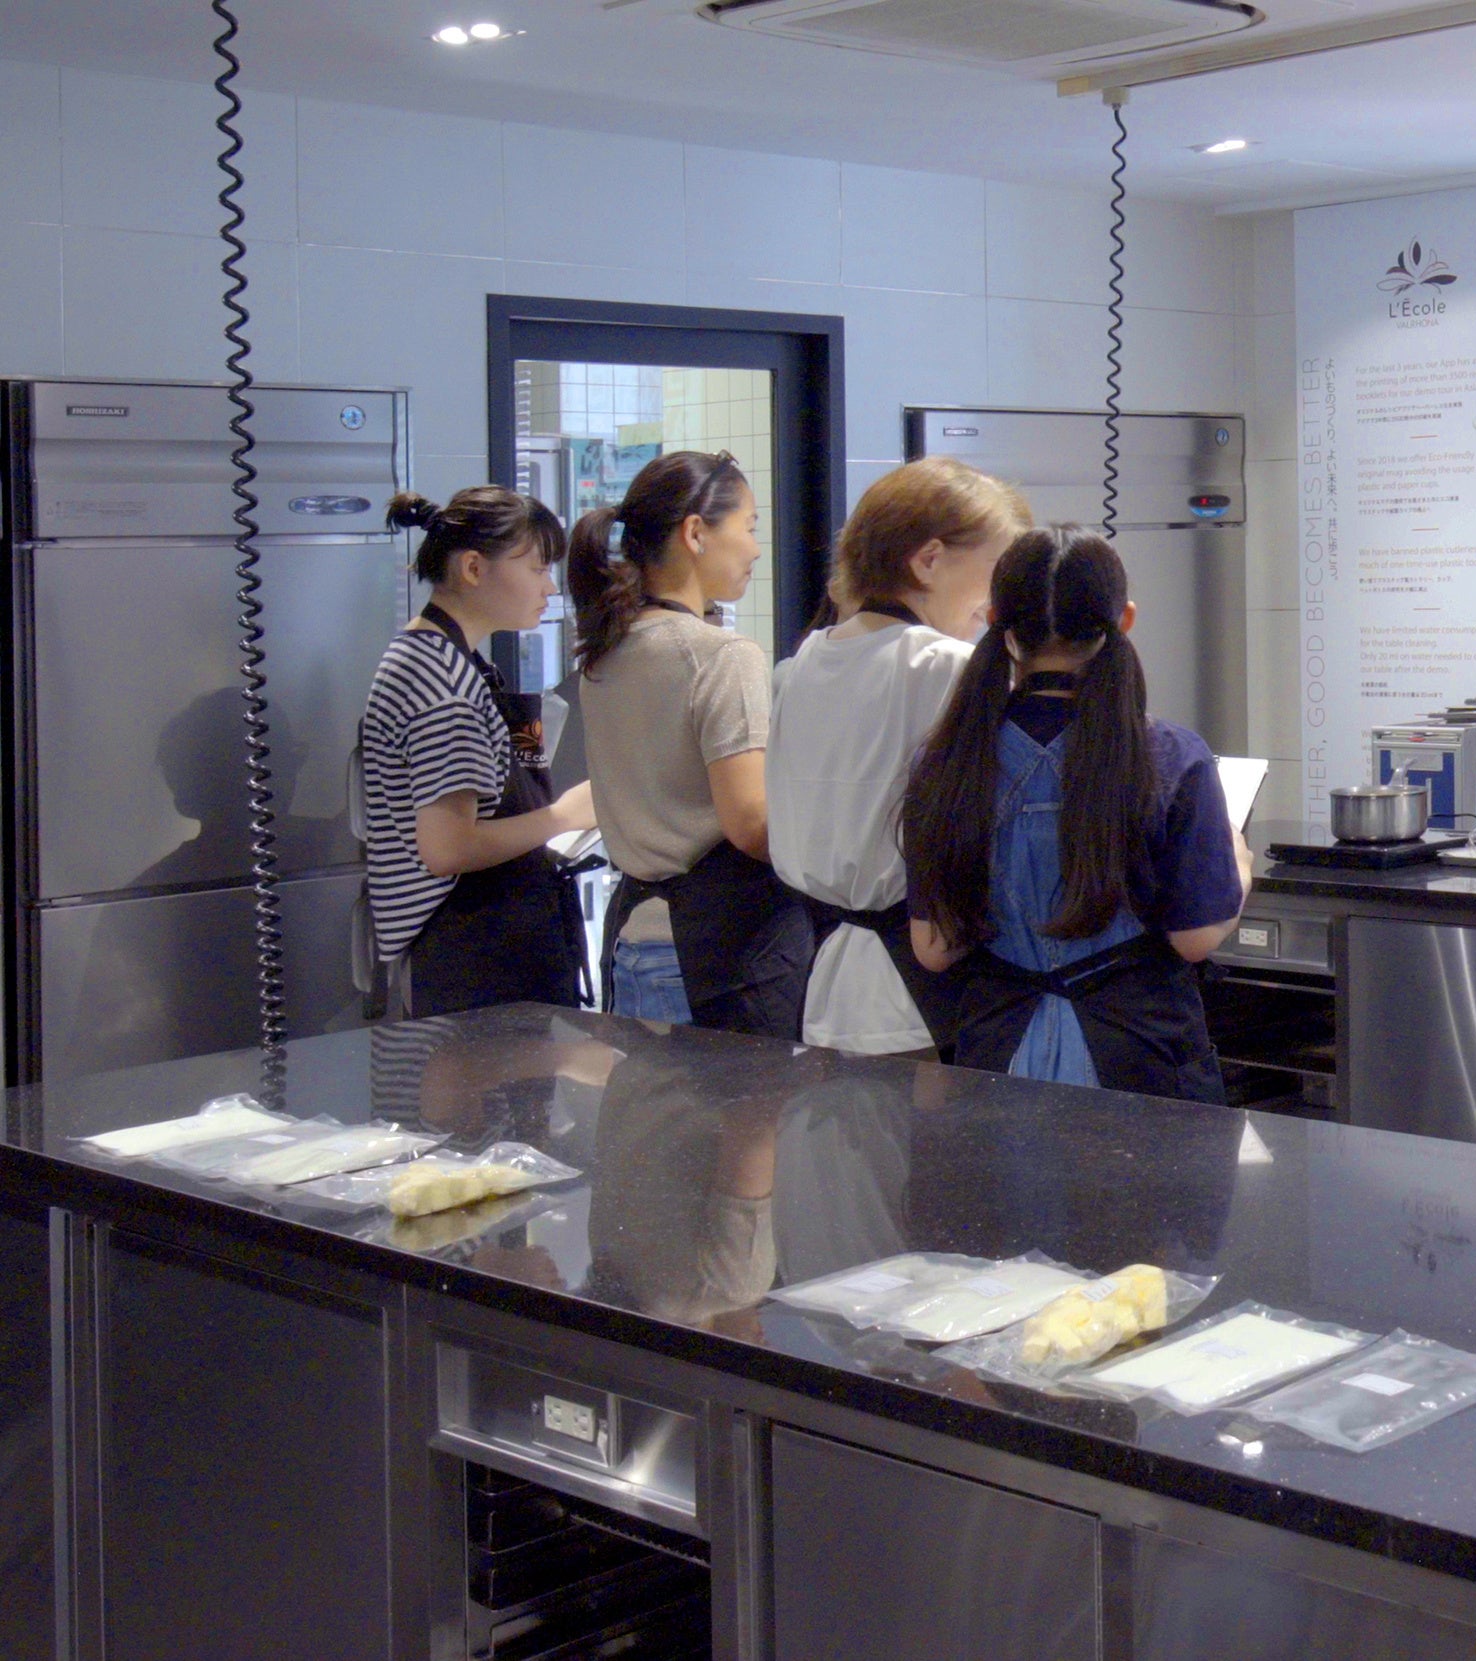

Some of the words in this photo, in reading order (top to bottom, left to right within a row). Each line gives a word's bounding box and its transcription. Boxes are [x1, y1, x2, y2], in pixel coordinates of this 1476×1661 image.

[1302, 357, 1321, 465] BETTER
[1304, 477, 1324, 622] BECOMES
[1306, 635, 1326, 728] GOOD
